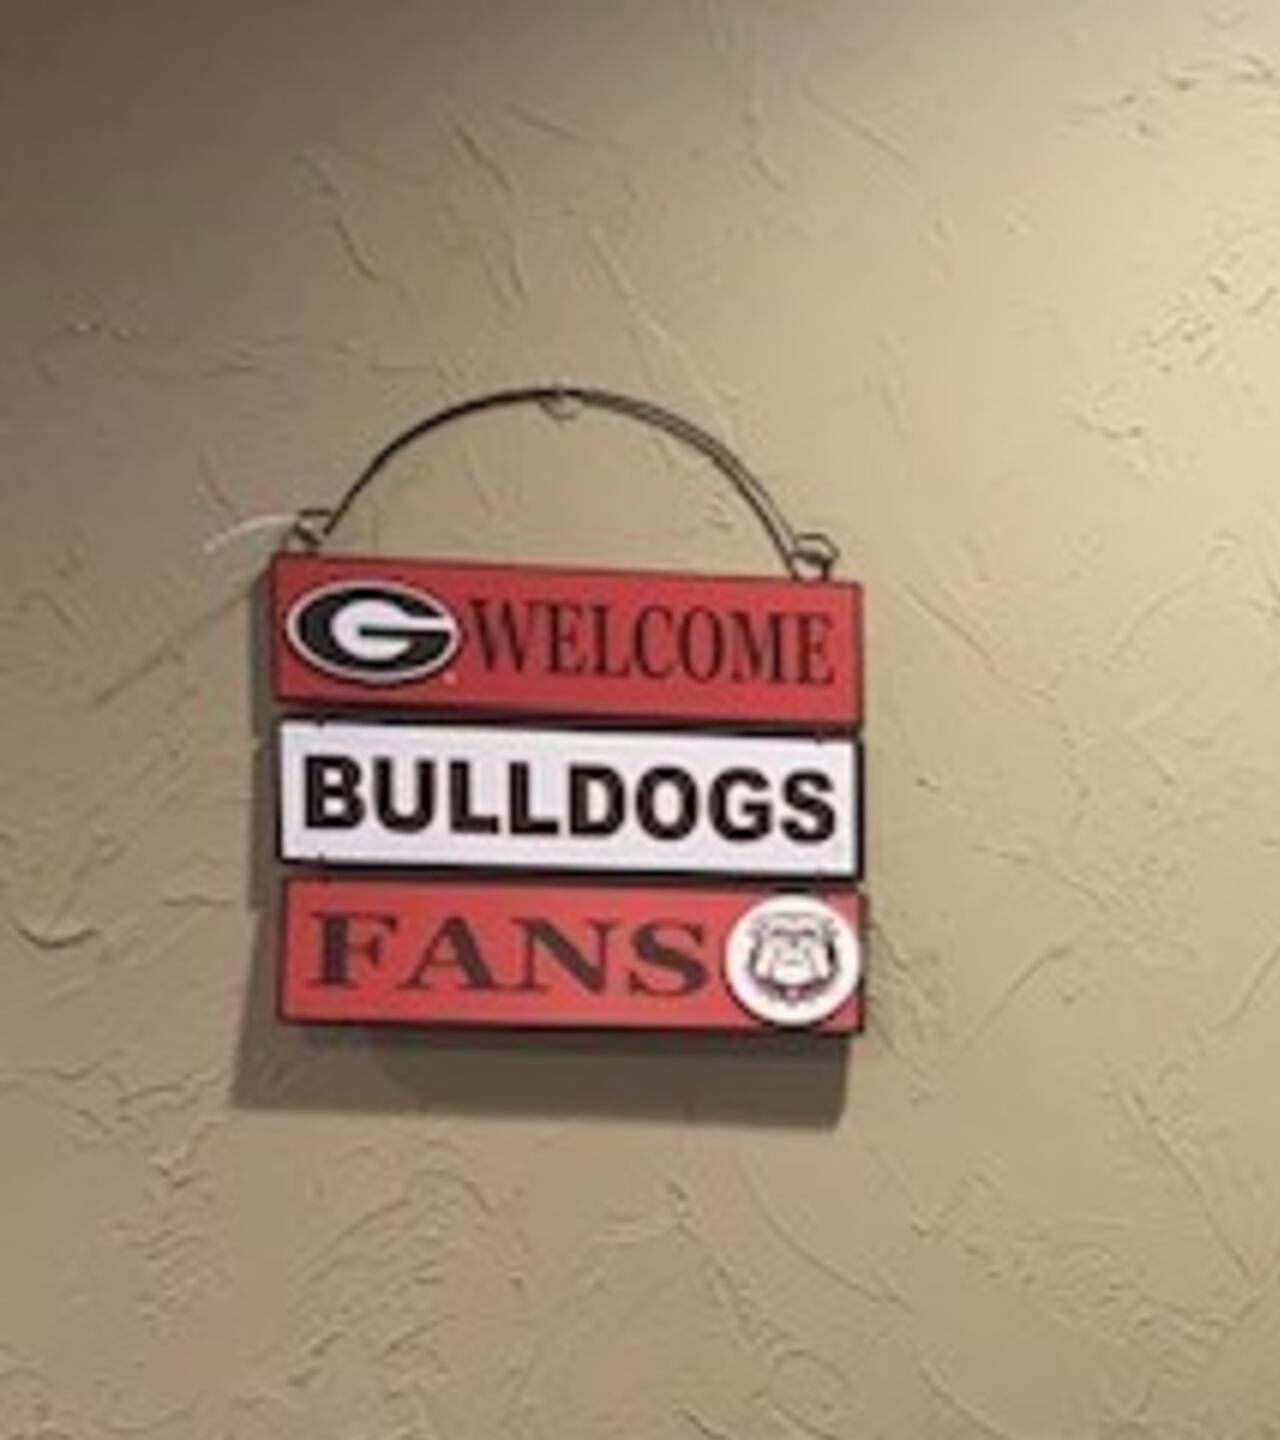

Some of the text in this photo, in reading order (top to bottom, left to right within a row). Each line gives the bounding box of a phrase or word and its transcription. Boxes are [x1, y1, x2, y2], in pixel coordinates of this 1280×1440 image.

[293, 584, 837, 687] G WELCOME
[302, 754, 837, 842] BULLDOGS
[306, 910, 710, 998] FANS
